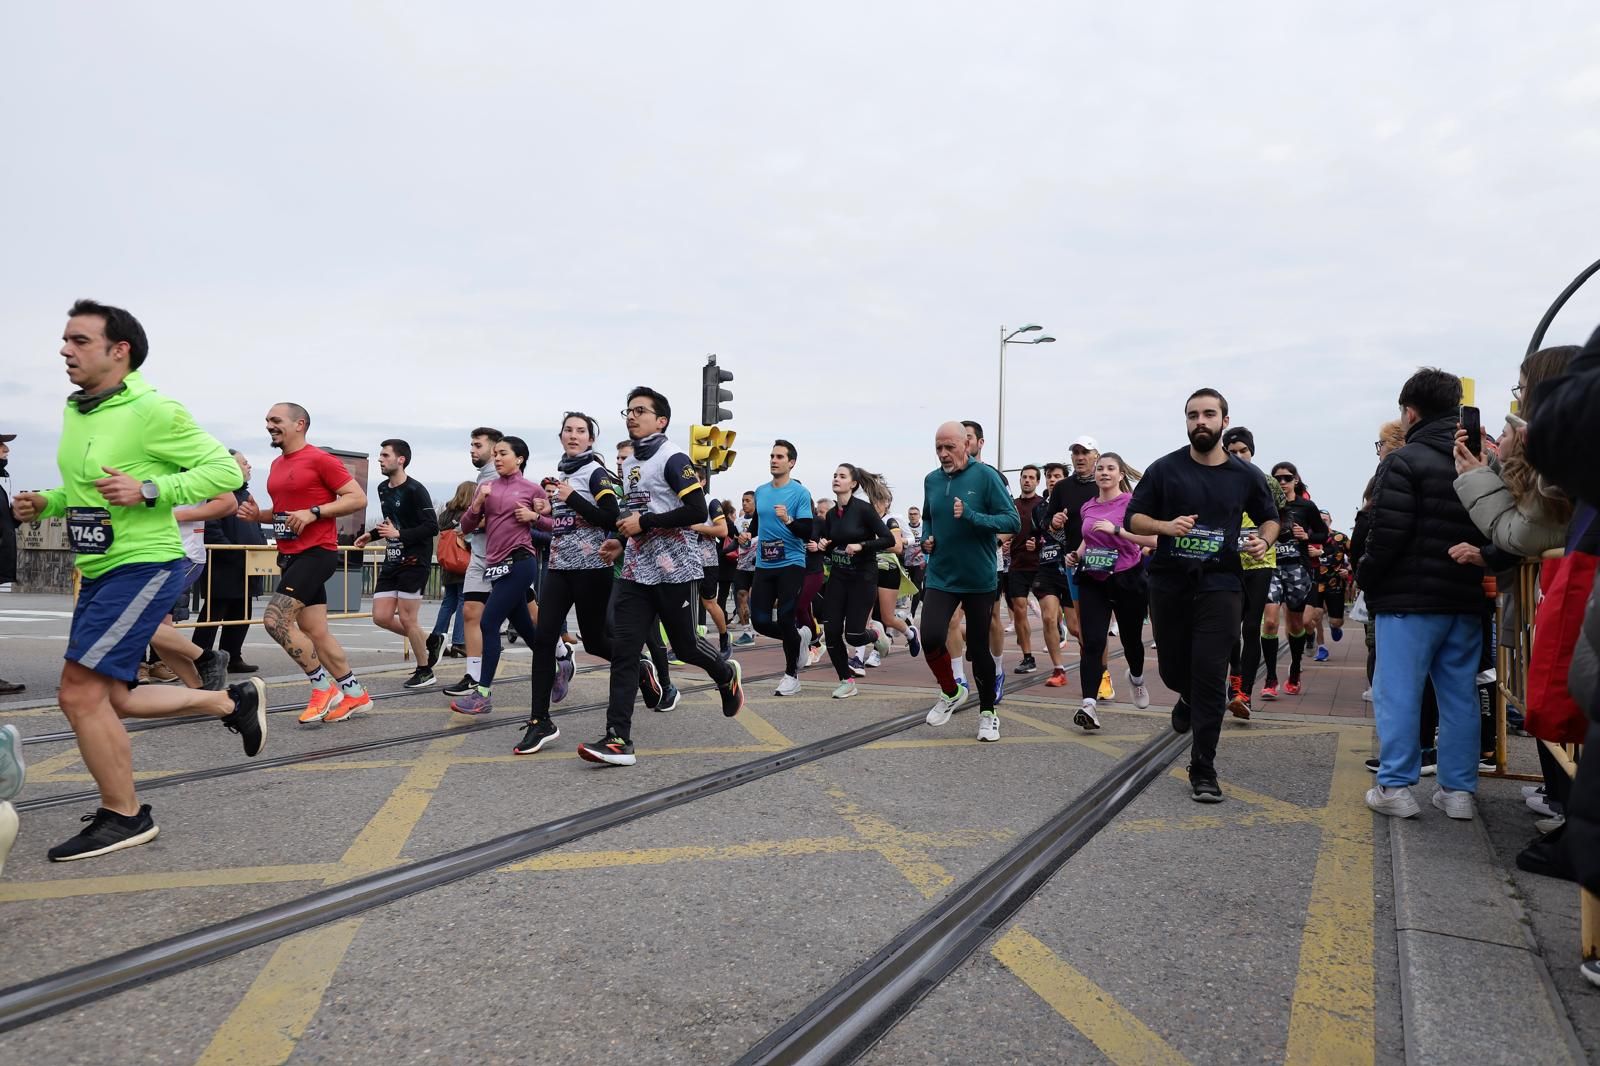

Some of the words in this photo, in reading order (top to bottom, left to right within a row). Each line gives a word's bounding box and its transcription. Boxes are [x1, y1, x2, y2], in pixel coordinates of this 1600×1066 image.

[70, 526, 106, 543] 1746
[1174, 537, 1220, 553] 10235
[1085, 555, 1113, 567] 10135
[485, 565, 509, 577] 2768
